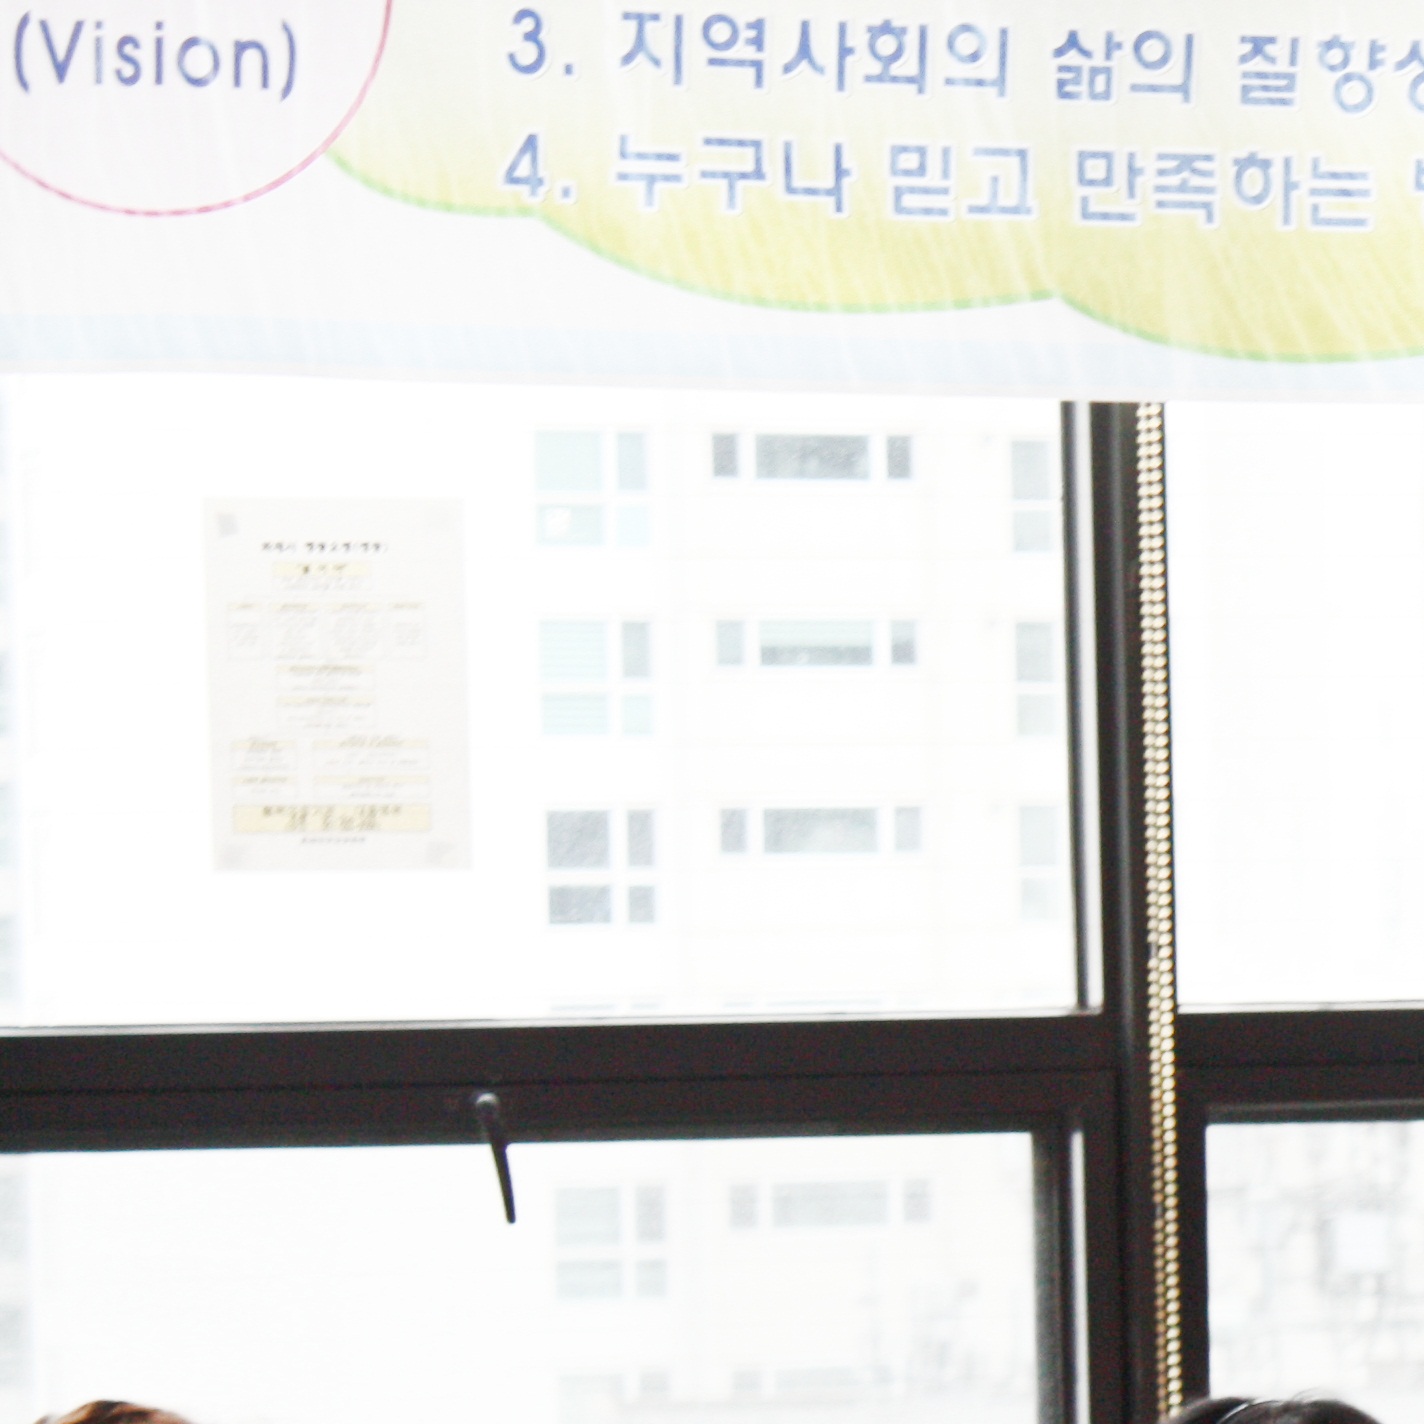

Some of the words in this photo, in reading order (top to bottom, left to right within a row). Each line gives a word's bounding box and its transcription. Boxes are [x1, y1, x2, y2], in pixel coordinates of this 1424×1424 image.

[12, 10, 298, 102] (Vision)
[507, 7, 576, 77] 3.
[619, 10, 1010, 98] 지역사회의
[1053, 29, 1195, 103] 삶의
[503, 132, 574, 198] 4.
[615, 133, 852, 214] 누구나
[888, 143, 1034, 218] 믿고
[1076, 149, 1373, 229] 만족하는
